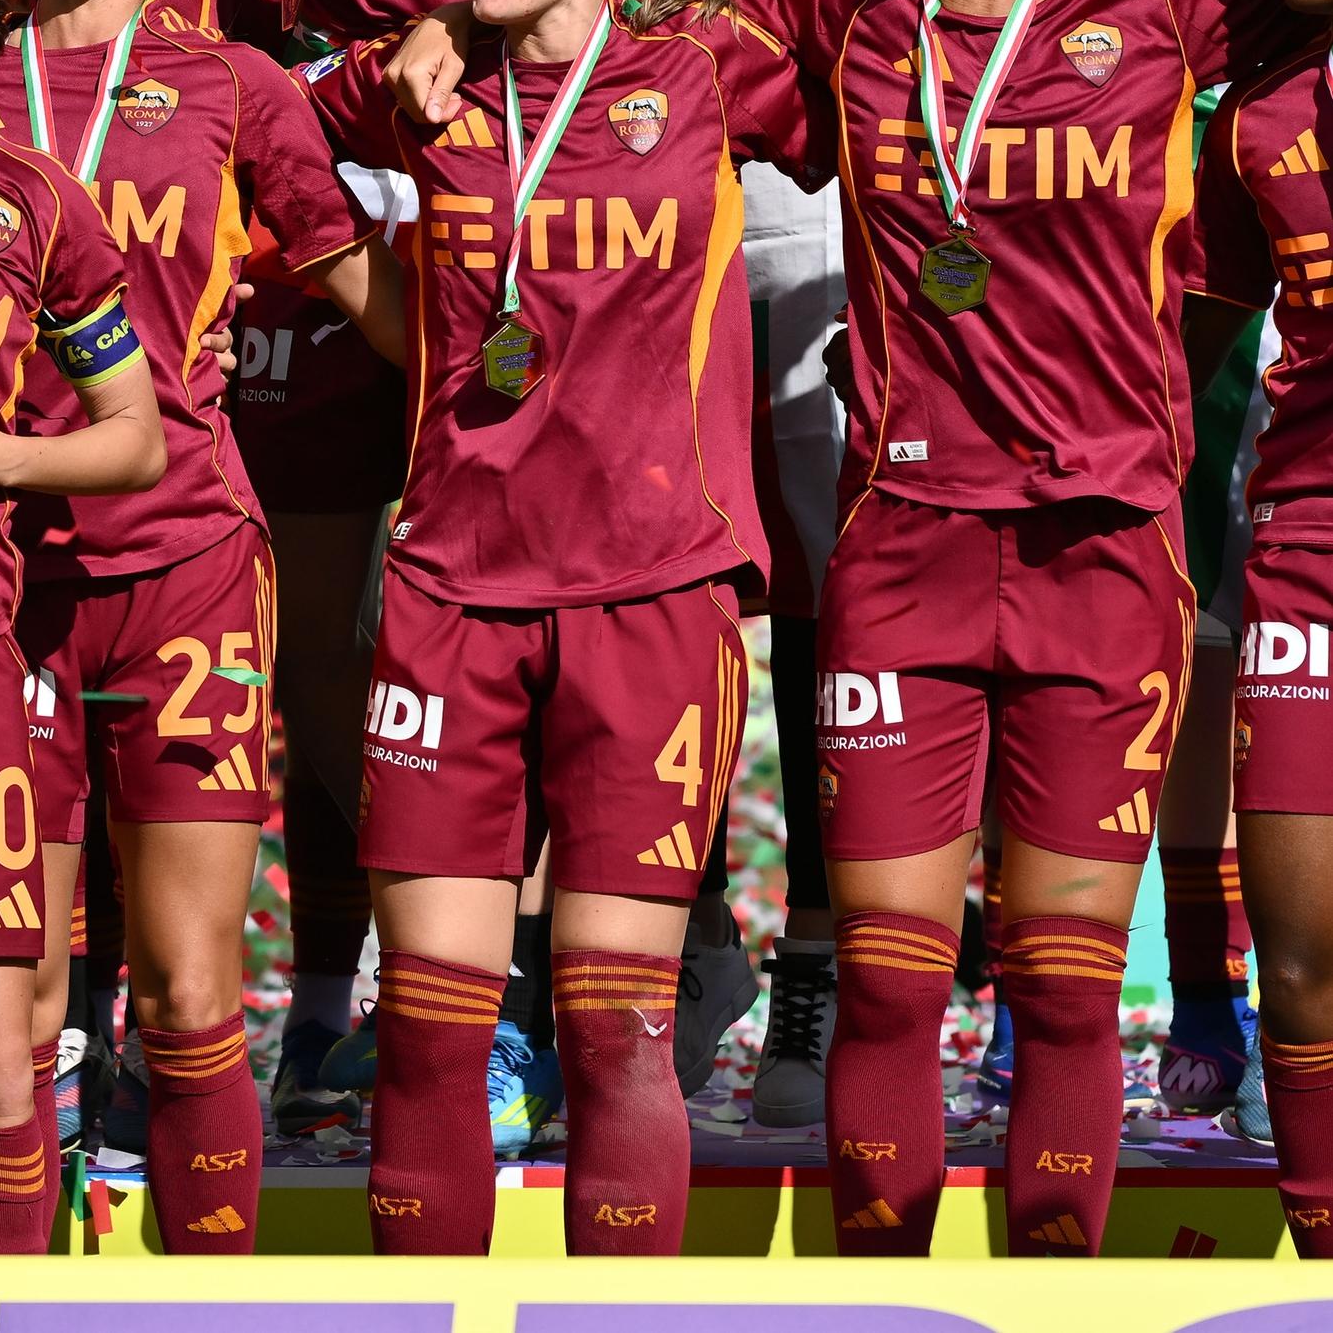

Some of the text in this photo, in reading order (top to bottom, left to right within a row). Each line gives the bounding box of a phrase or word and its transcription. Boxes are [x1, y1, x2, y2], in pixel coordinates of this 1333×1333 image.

[1074, 53, 1117, 67] ROMA
[1088, 68, 1106, 77] 1927
[124, 108, 168, 121] ROMA
[135, 120, 154, 128] 1927
[619, 121, 662, 137] ROMA
[979, 125, 1133, 200] TIM
[523, 196, 678, 271] TIM
[240, 326, 294, 381] DI
[1237, 621, 1330, 677] HDI
[156, 631, 259, 737] 25
[815, 671, 904, 727] HDI
[364, 678, 444, 750] HDI
[1123, 670, 1171, 771] 2
[653, 703, 704, 807] 4
[190, 1148, 247, 1172] ASR
[838, 1139, 897, 1161] ASR
[1036, 1150, 1094, 1175] ASR
[594, 1204, 657, 1227] ASR
